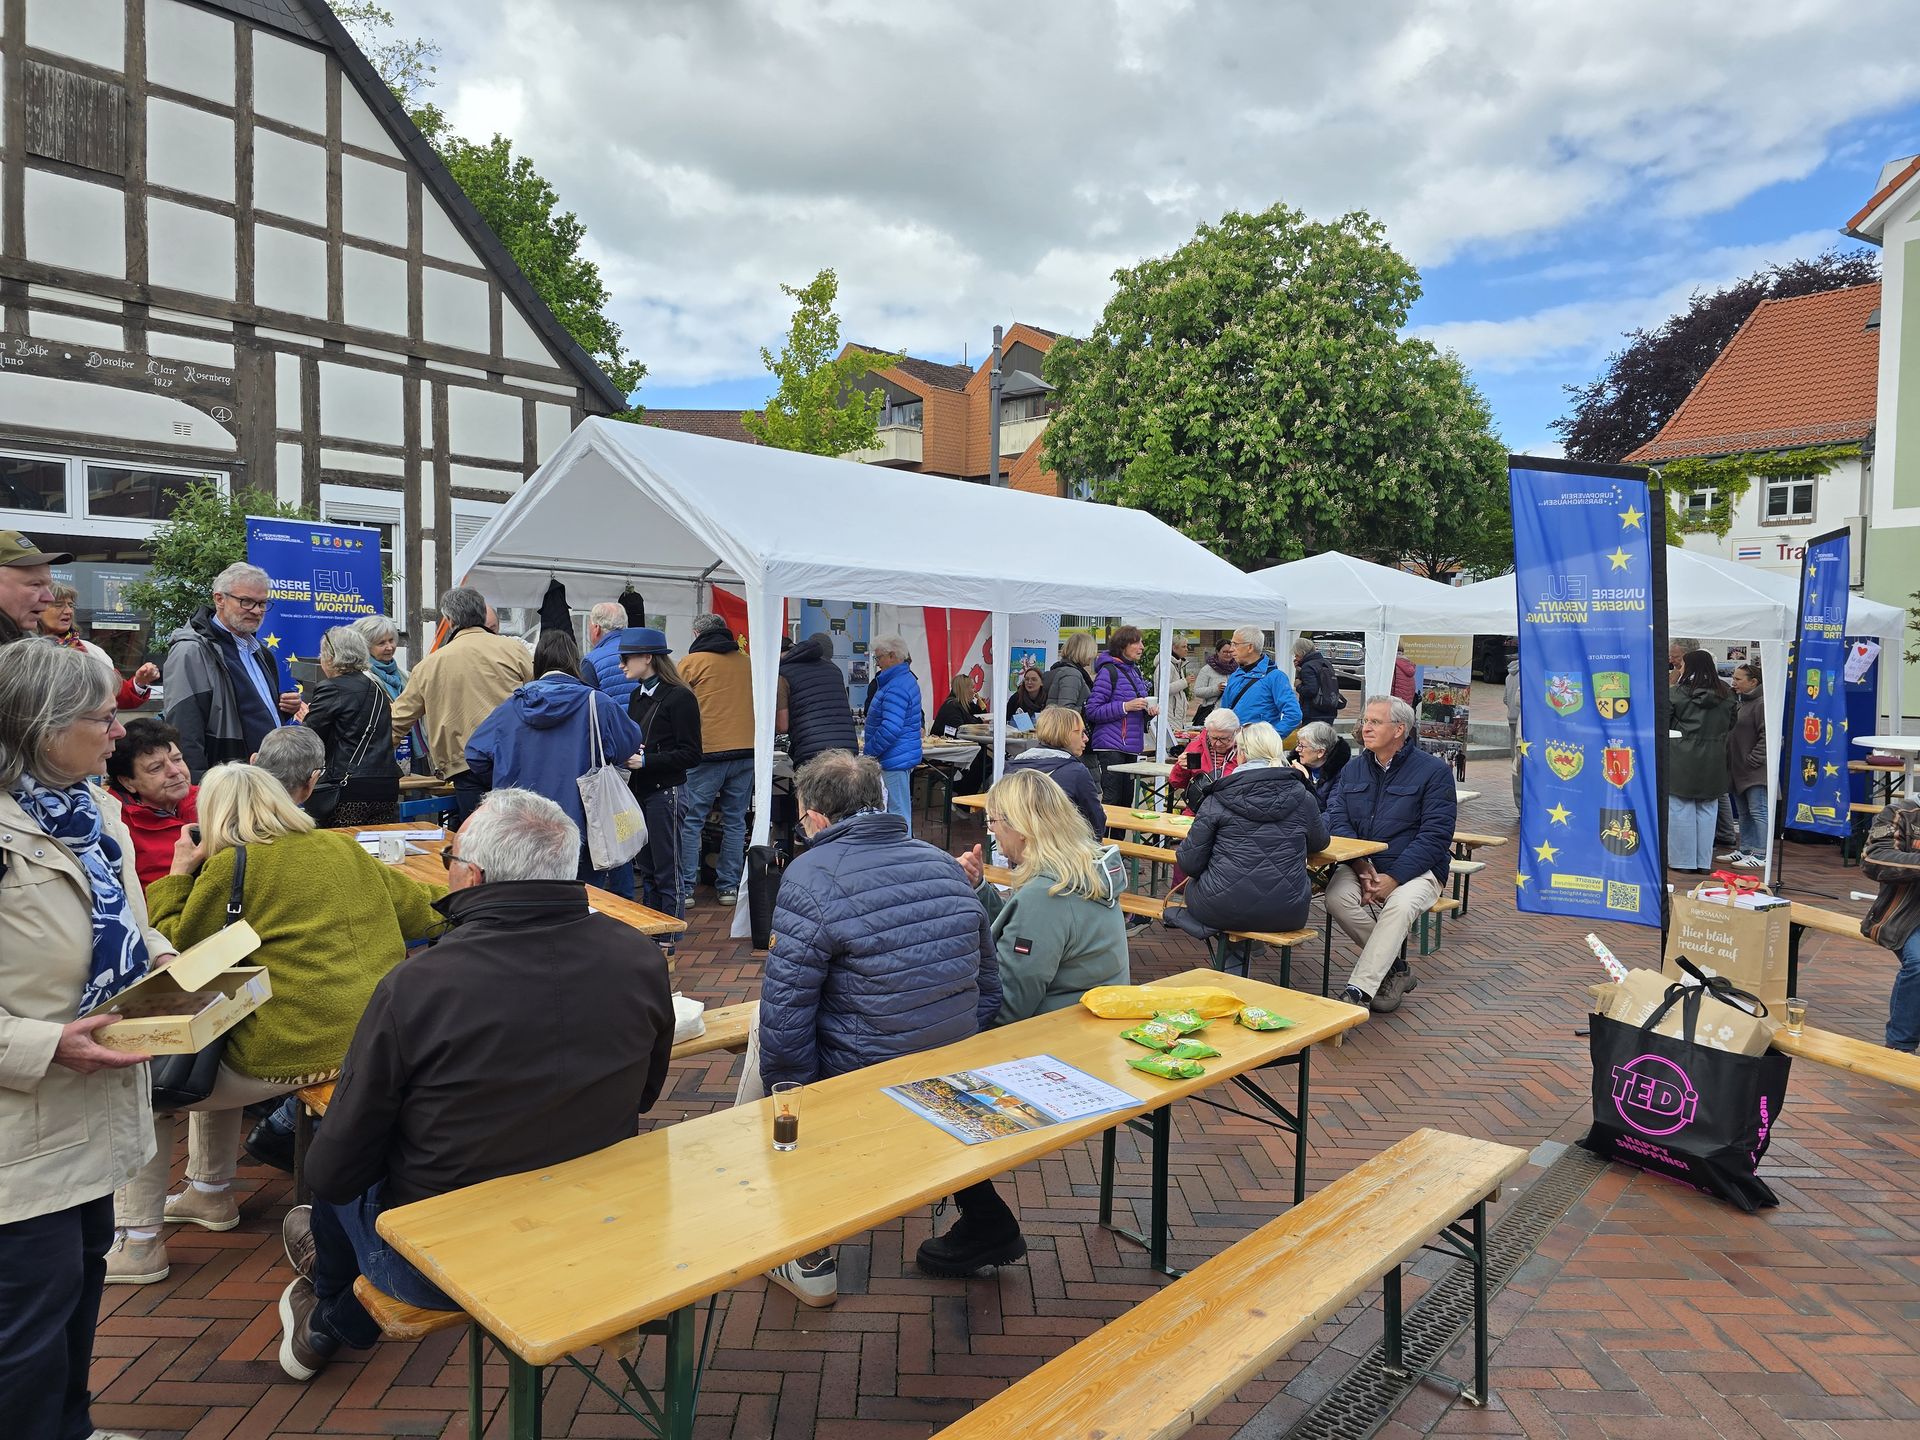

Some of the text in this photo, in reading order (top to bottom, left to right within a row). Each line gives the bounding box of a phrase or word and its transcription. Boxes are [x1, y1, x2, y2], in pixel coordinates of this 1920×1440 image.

[145, 359, 177, 376] Clare
[183, 366, 231, 385] Rosenberg
[153, 377, 173, 388] 1827
[270, 568, 359, 594] NSERE EU.
[314, 592, 365, 604] VERANT-
[315, 602, 377, 614] WORTUNG.
[1690, 907, 1730, 921] ROSSMANN
[1682, 925, 1735, 946] Hier blüht
[1677, 936, 1739, 963] Freude auf
[1611, 1065, 1699, 1123] TEDi
[1615, 1138, 1691, 1171] SHOPPING!
[1623, 1134, 1670, 1156] HAPPY
